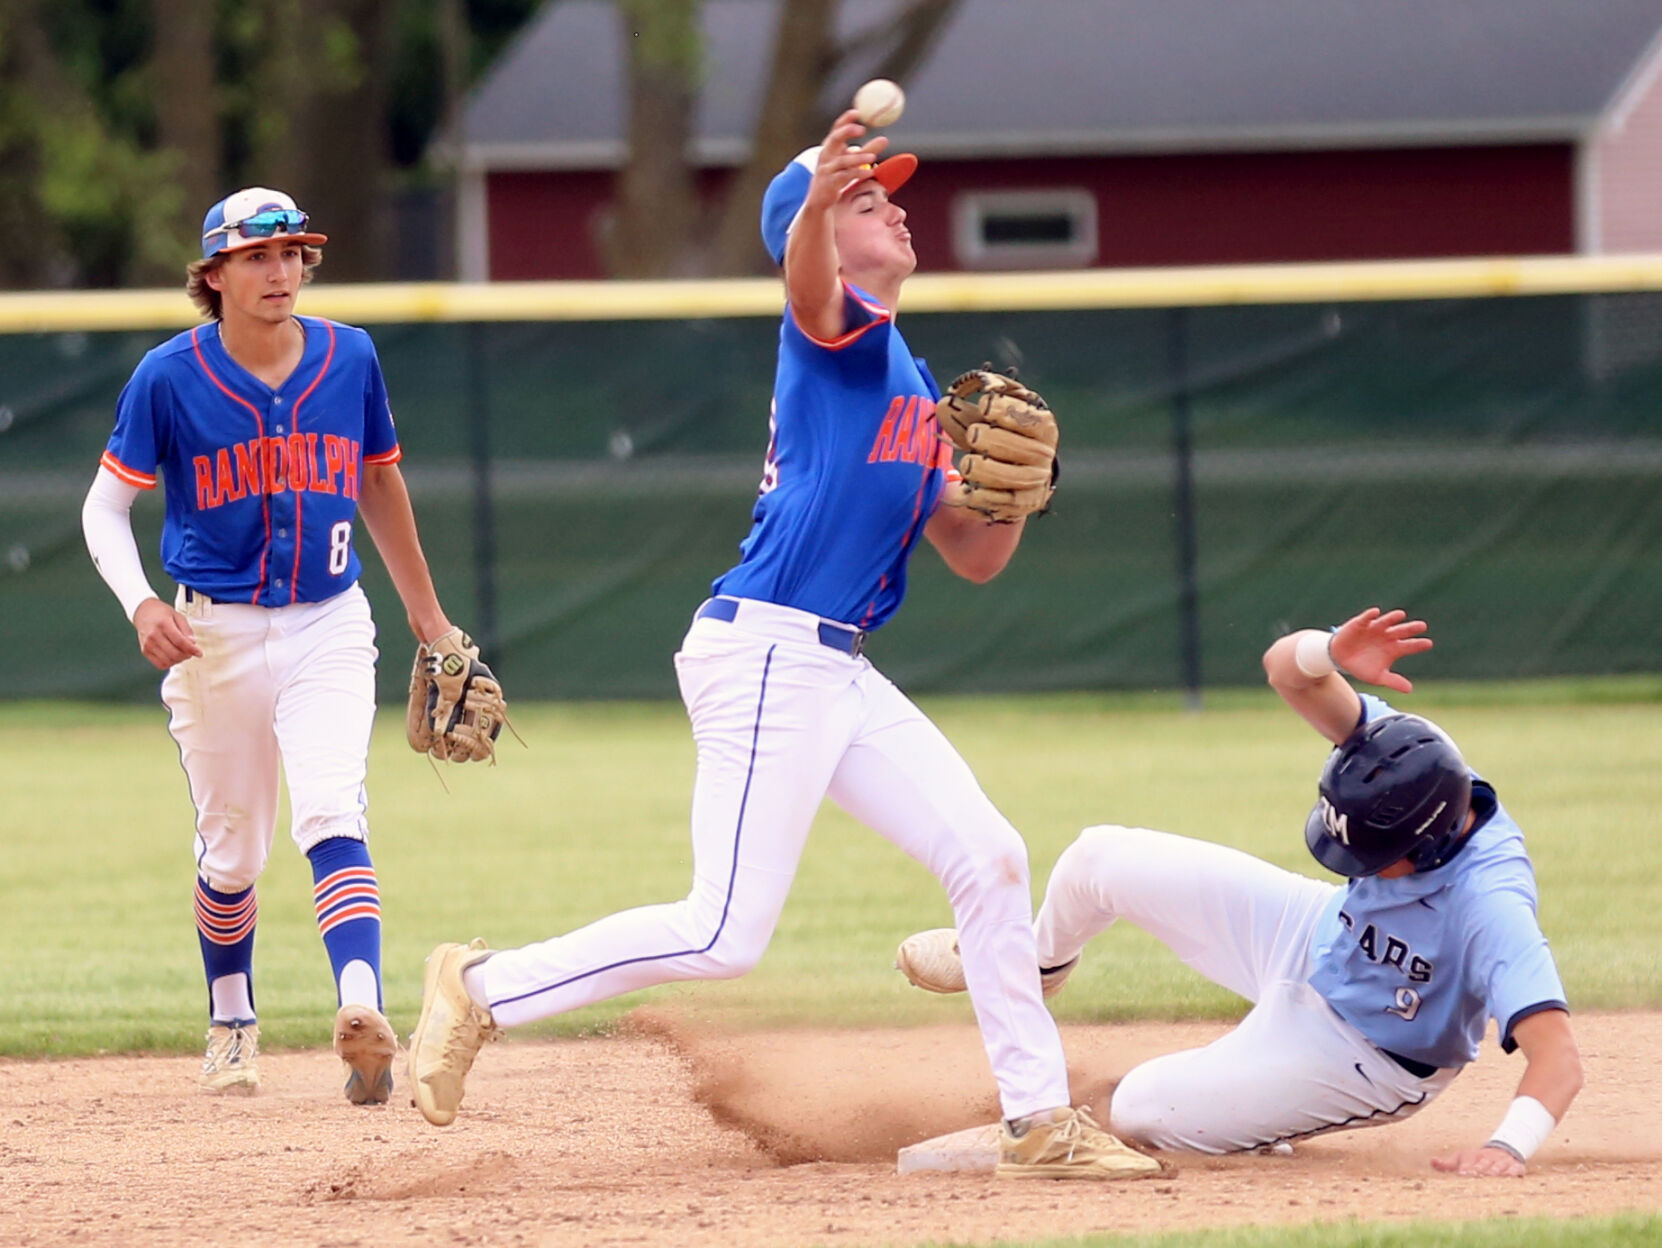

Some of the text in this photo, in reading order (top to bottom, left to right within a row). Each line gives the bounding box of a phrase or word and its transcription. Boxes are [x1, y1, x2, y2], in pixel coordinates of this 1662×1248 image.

[193, 433, 359, 510] RANDOLPH
[328, 520, 352, 576] 8
[1384, 986, 1423, 1022] 9
